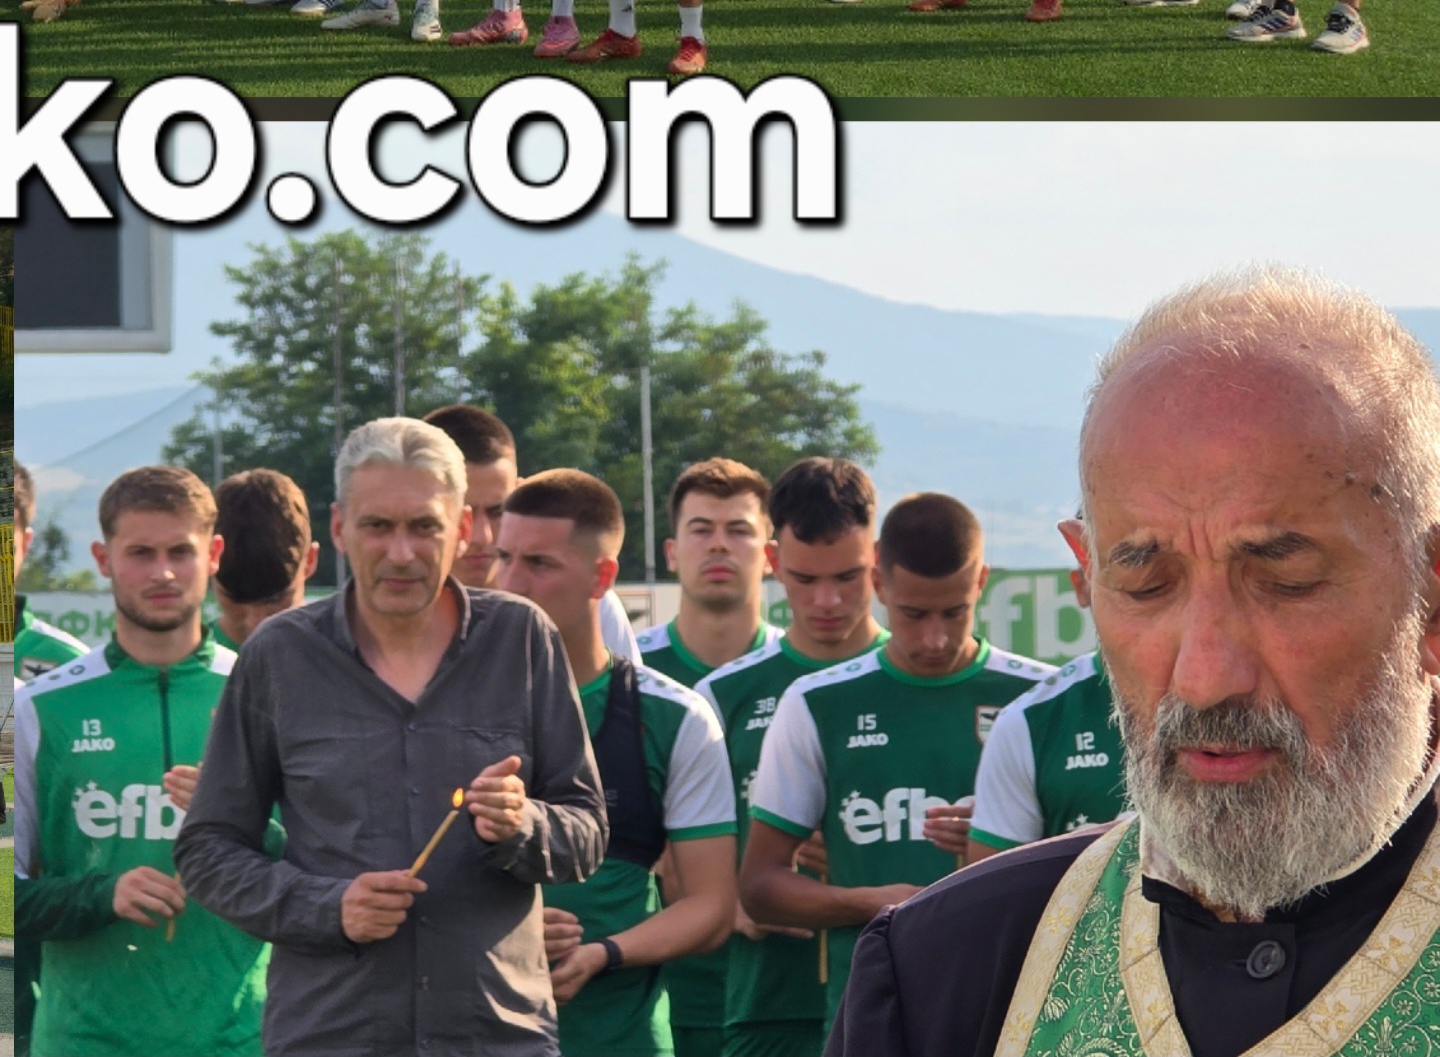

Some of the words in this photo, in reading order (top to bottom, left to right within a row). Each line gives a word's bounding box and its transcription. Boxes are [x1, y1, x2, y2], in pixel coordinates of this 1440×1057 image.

[82, 718, 102, 737] 13
[745, 716, 774, 731] JAK
[857, 713, 878, 731] 15
[71, 737, 116, 753] JAKO
[846, 733, 890, 749] JAKO
[1075, 731, 1096, 751] 12
[1065, 752, 1110, 771] JAKO
[74, 784, 187, 840] efb
[843, 787, 976, 845] efb
